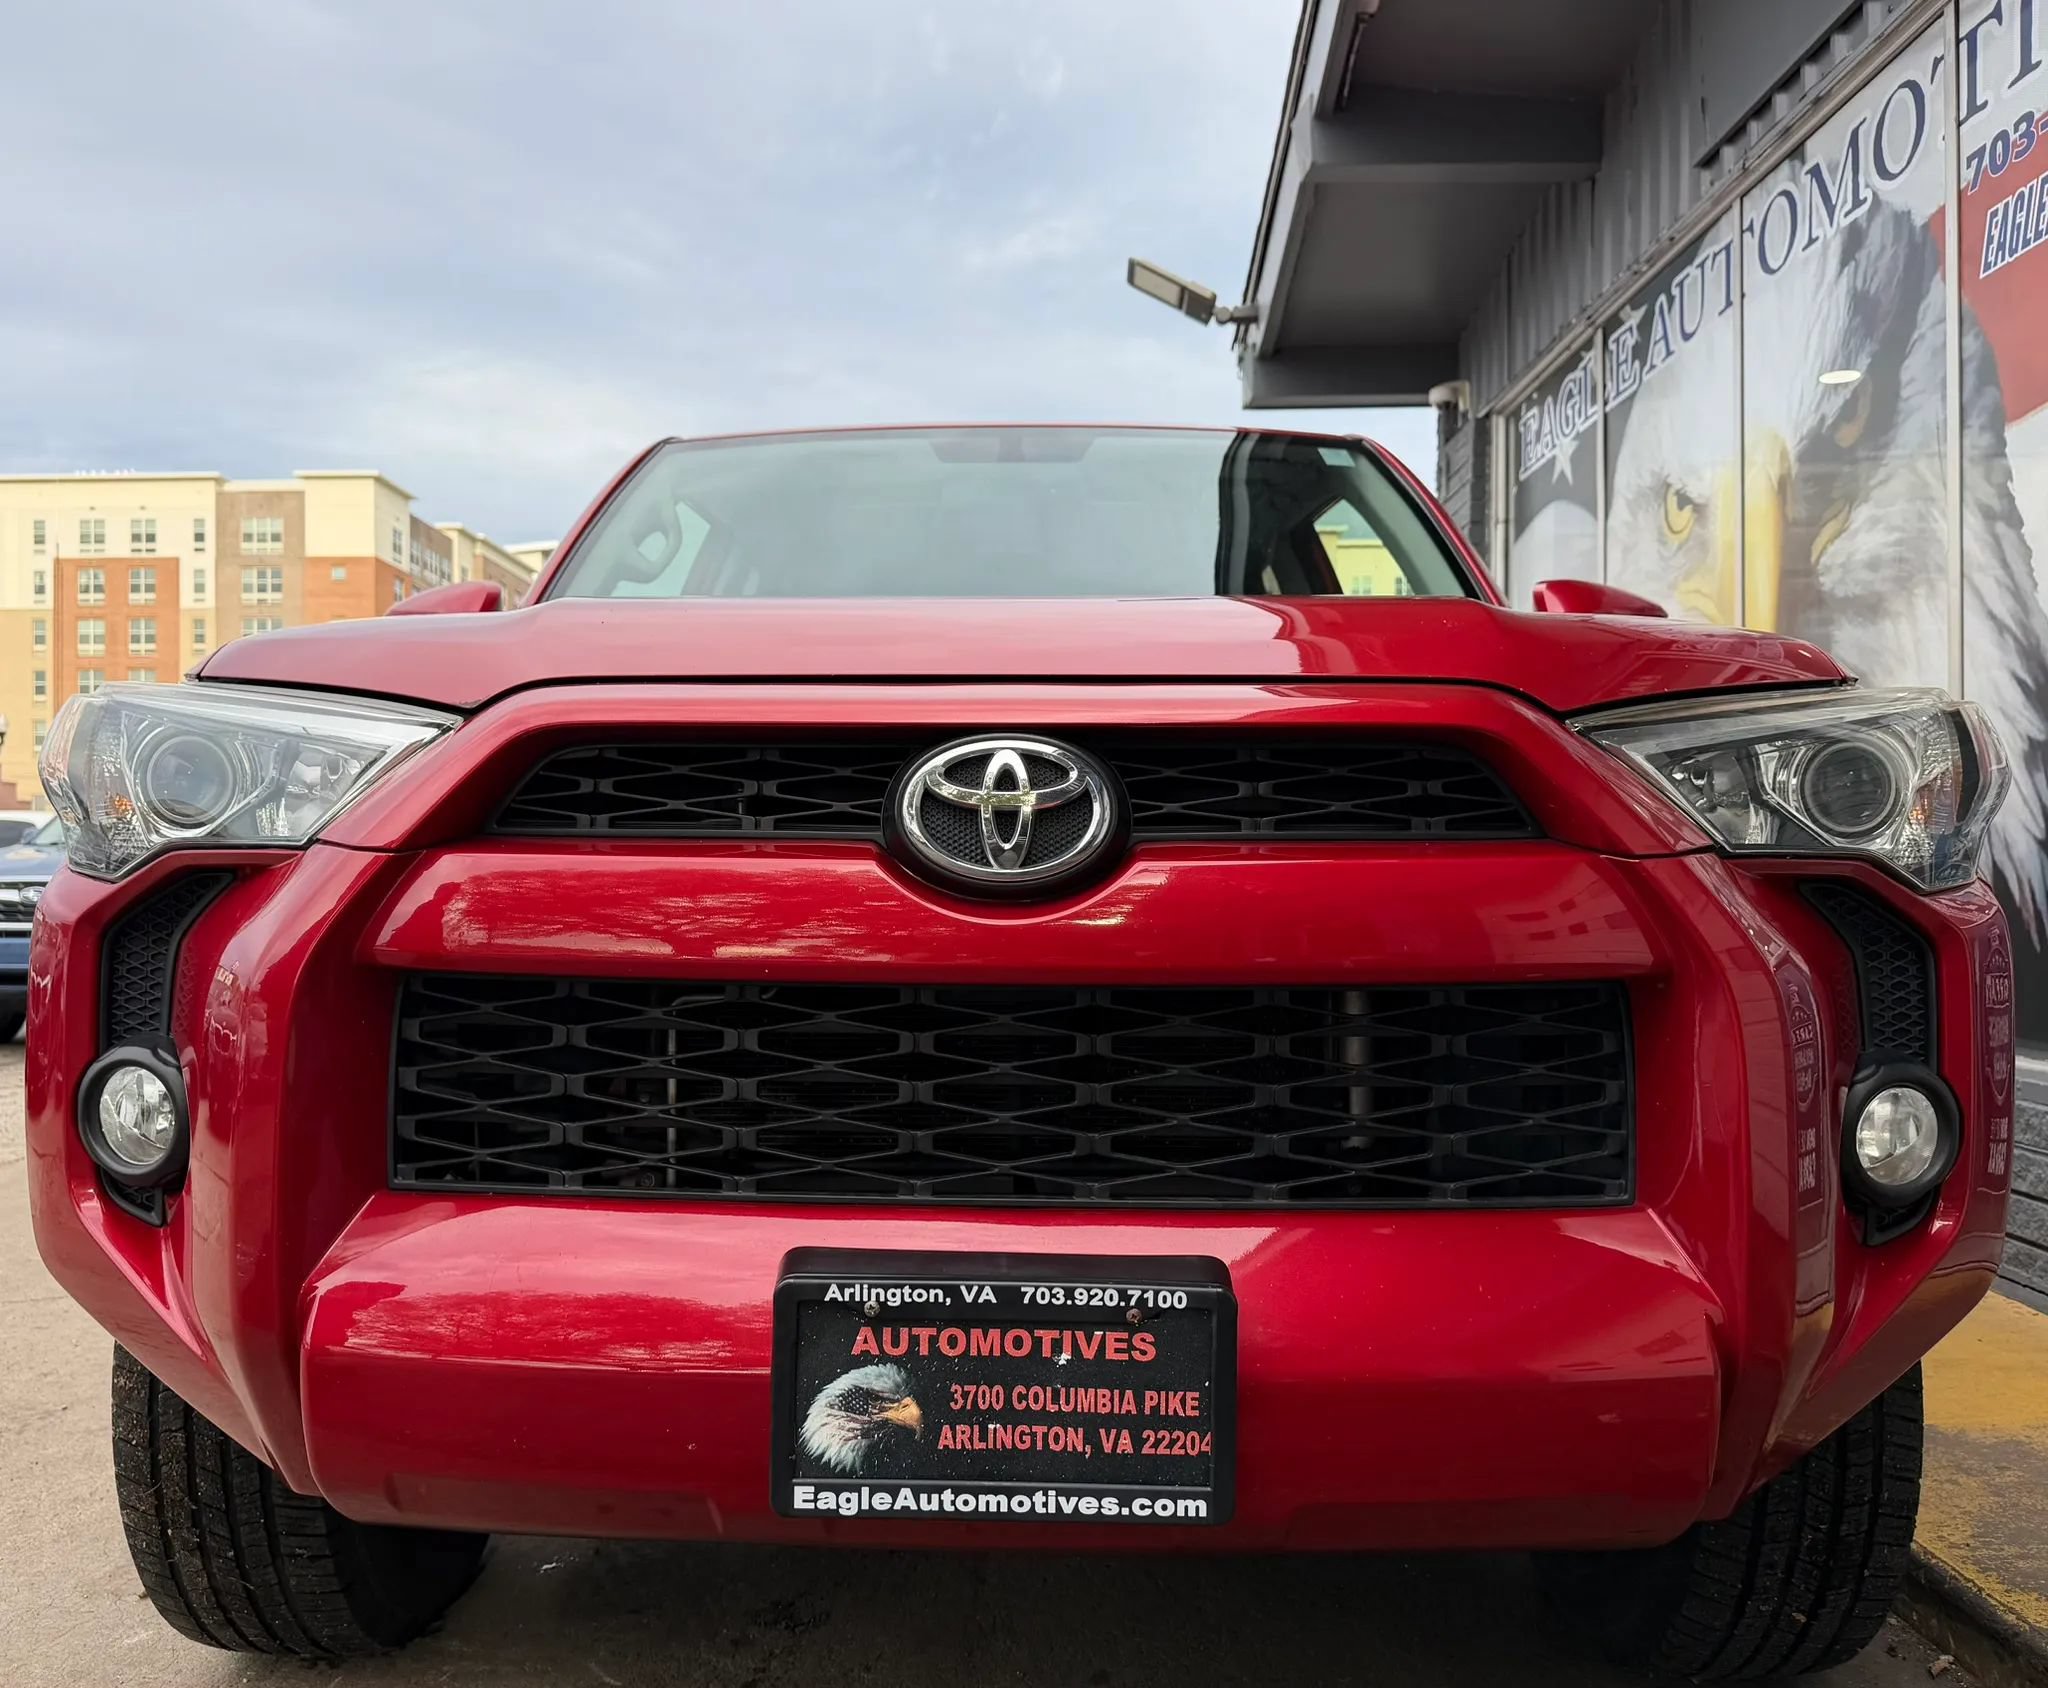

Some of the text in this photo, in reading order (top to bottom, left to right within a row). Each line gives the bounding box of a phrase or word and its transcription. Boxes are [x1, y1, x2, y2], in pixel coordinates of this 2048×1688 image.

[1518, 318, 1642, 482] EAGLE
[824, 1283, 1188, 1310] Arlington, VA 703.920.7100
[850, 1326, 1158, 1363] AUTOMOTIVES
[949, 1384, 1201, 1417] 3700 COLUMBIA PIKE
[937, 1423, 1213, 1459] ARLINGTON, VA 22204
[792, 1484, 1208, 1518] EagleAutomotives.com
